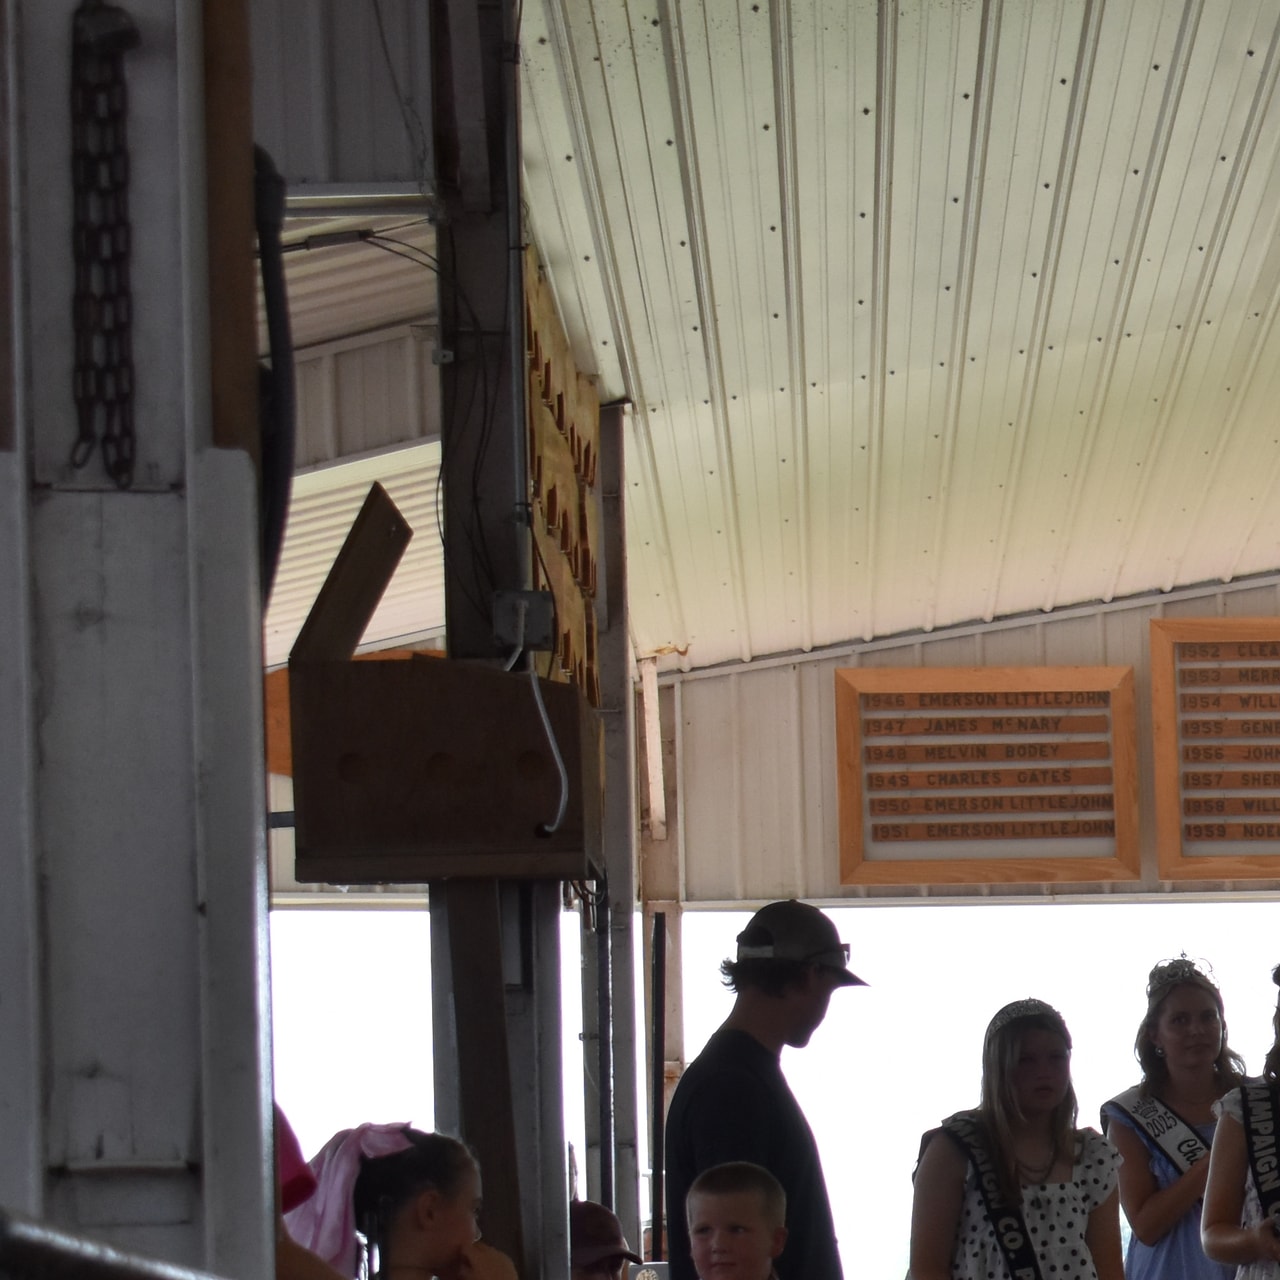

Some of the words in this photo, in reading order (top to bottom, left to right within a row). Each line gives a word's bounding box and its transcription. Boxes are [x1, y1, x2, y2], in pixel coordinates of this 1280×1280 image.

[1183, 695, 1222, 708] 1954
[866, 719, 905, 733] 1947
[923, 718, 978, 733] JAMES
[1183, 722, 1223, 735] 1955
[925, 746, 987, 760] MELVIN
[1005, 744, 1059, 758] BODEY
[869, 774, 910, 788] 1949
[927, 772, 1001, 786] CHARLES
[1017, 770, 1073, 784] GATES
[1185, 773, 1223, 787] 1957
[924, 797, 1003, 812] EMERSON
[1186, 824, 1226, 838] 1959
[1146, 1111, 1178, 1138] 2025
[997, 1217, 1024, 1260] CO.
